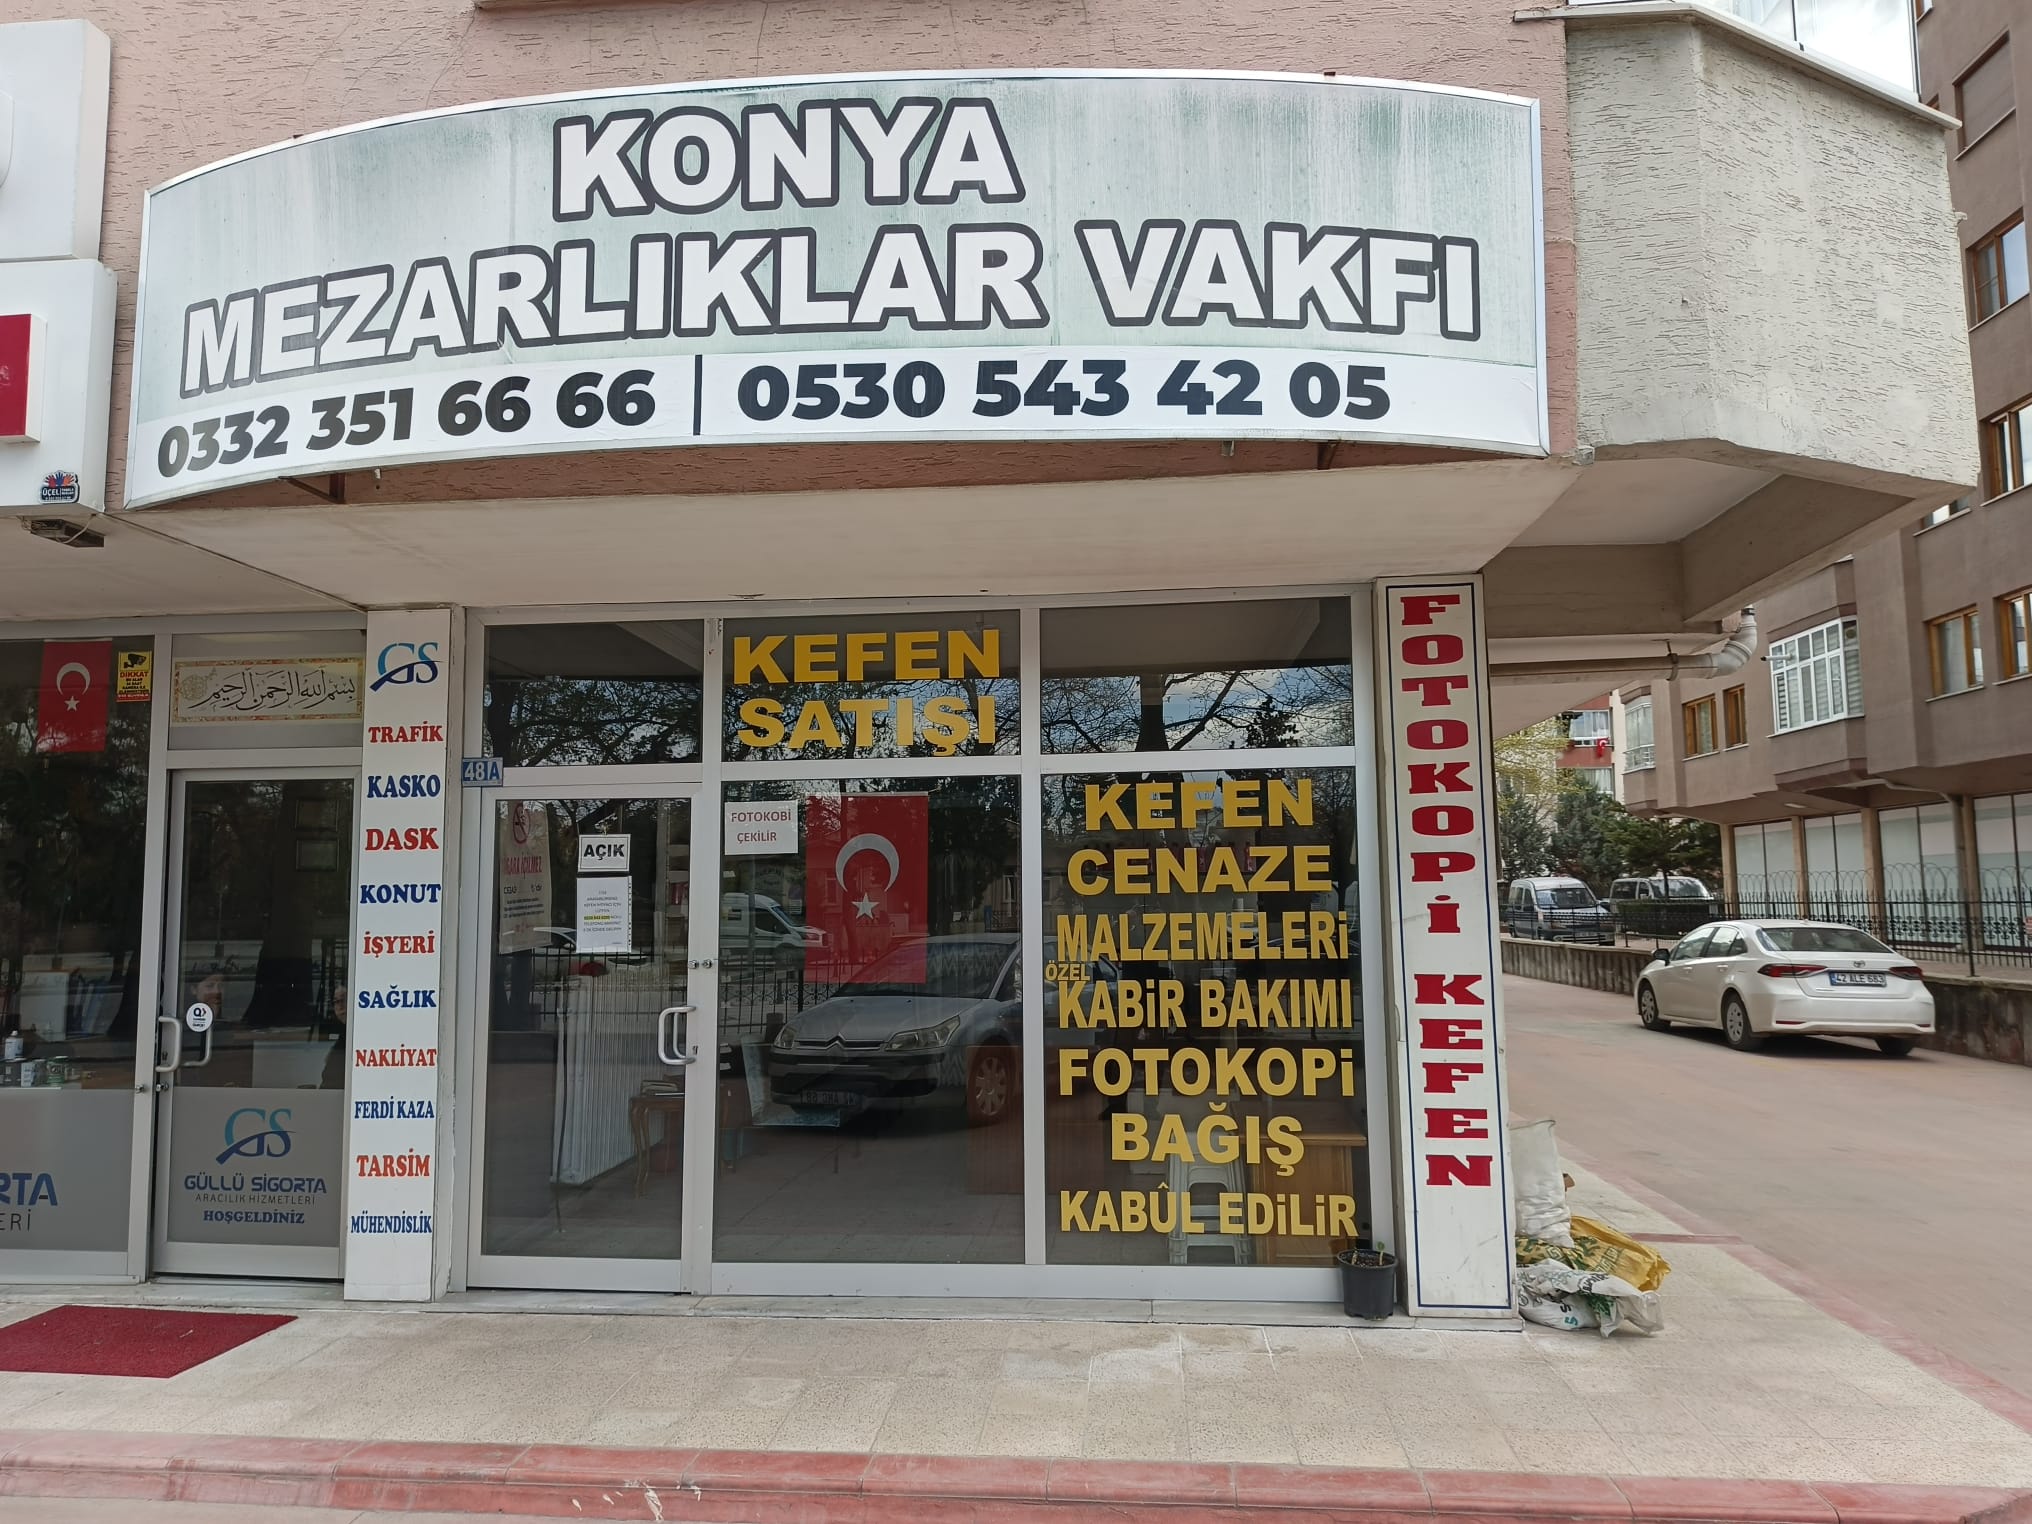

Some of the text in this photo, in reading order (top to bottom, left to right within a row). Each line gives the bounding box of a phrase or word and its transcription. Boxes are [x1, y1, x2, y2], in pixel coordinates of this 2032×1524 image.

[553, 97, 1025, 222] KONYA
[180, 219, 1480, 398] MEZARLIKLAR VAKFI
[737, 359, 1391, 420] 0530 543 42 05
[157, 370, 655, 477] 0332 351 66 66
[733, 629, 1000, 685] KEFEN
[368, 721, 443, 743] TRAFİK
[737, 695, 996, 757] SATIŞI
[367, 774, 441, 798] KASKO
[731, 809, 791, 822] FOTOKOBİ
[1085, 779, 1313, 831] KEFEN
[365, 828, 439, 851] DASK
[737, 829, 777, 844] ÇEKİLİR
[583, 844, 625, 861] AÇIK
[1067, 845, 1333, 896] CENAZE
[360, 884, 441, 904] KONUT
[363, 930, 435, 958] İŞYERİ
[1045, 960, 1090, 981] ÖZEL
[358, 985, 436, 1008] SAĞLIK
[1200, 979, 1353, 1028] BAKIMI
[355, 1044, 437, 1067] NAKLİYAT
[1414, 973, 1493, 1187] KEFEN
[354, 1096, 435, 1119] FERDİ KAZA
[1111, 1101, 1305, 1177] BAĞIŞ
[356, 1148, 430, 1177] TARSİM
[184, 1172, 327, 1194] GÜLLÜ SİGORTA
[195, 1192, 316, 1206] ARACILIK HİZMETLERİ
[1060, 1182, 1205, 1234] KABÛL
[203, 1208, 305, 1224] HOŞGELDİNİZ
[350, 1210, 432, 1234] MÜHENDİSLİK
